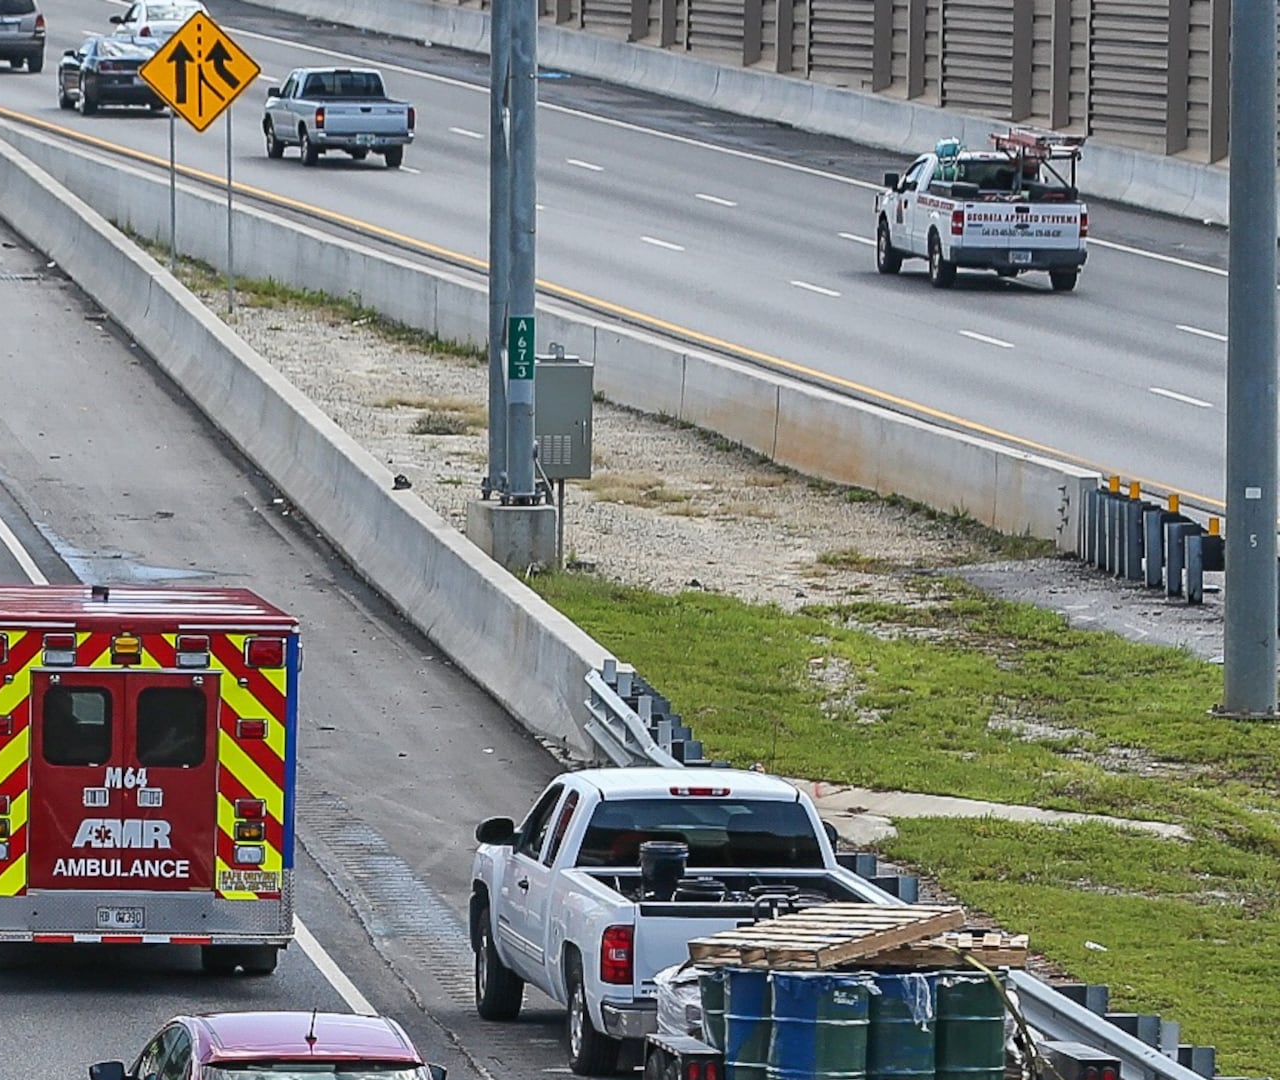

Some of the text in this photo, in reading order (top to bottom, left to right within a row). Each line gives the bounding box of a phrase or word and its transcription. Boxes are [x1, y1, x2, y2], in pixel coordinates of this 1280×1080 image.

[517, 319, 528, 332] A
[104, 767, 148, 789] M64
[72, 818, 172, 849] AMR
[52, 858, 190, 878] AMBULANCE
